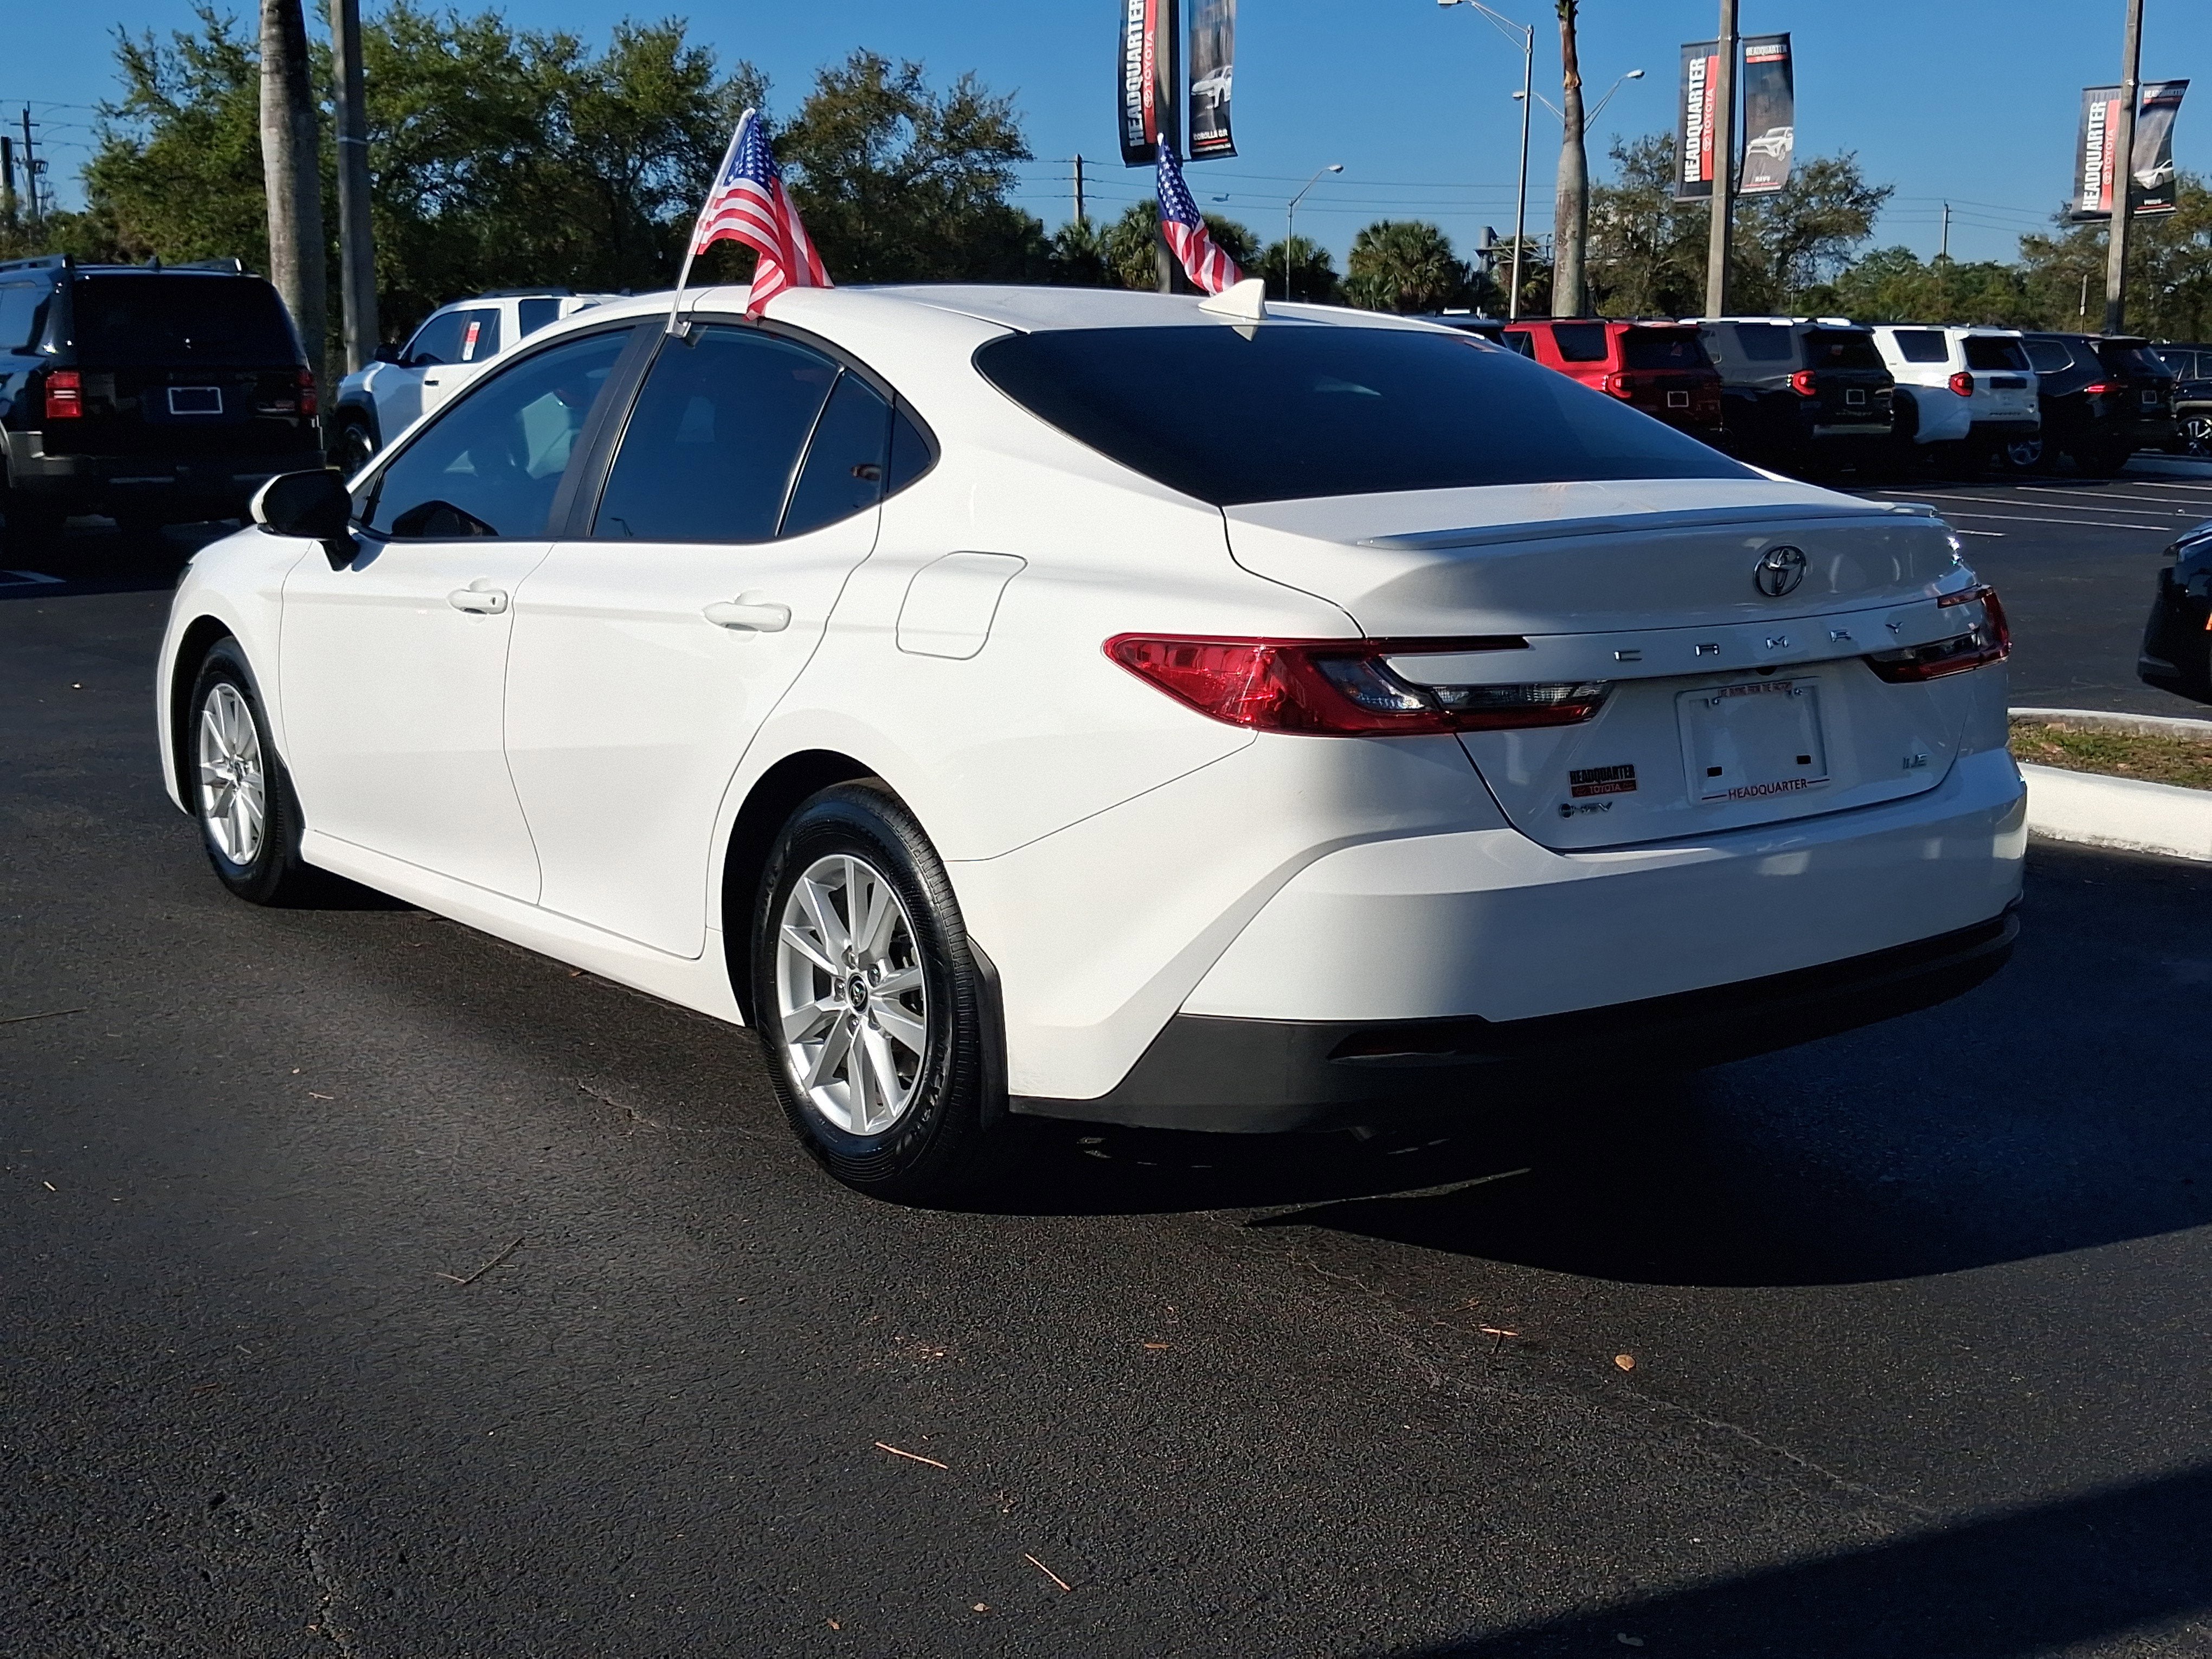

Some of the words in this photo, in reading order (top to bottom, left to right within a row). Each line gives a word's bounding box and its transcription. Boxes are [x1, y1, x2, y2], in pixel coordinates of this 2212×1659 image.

[1144, 31, 1154, 87] TOYOTA
[1684, 57, 1707, 182] HEADQUARTER
[1703, 88, 1715, 136] TOYOTA
[2081, 101, 2106, 210] HEADQUARTER
[2105, 129, 2114, 173] TOYOTA
[1613, 621, 1902, 662] CAMRY
[1569, 764, 1635, 785] HEADQUARTER
[1589, 783, 1622, 795] TOYOTA
[1728, 779, 1808, 800] HEADQUARTER
